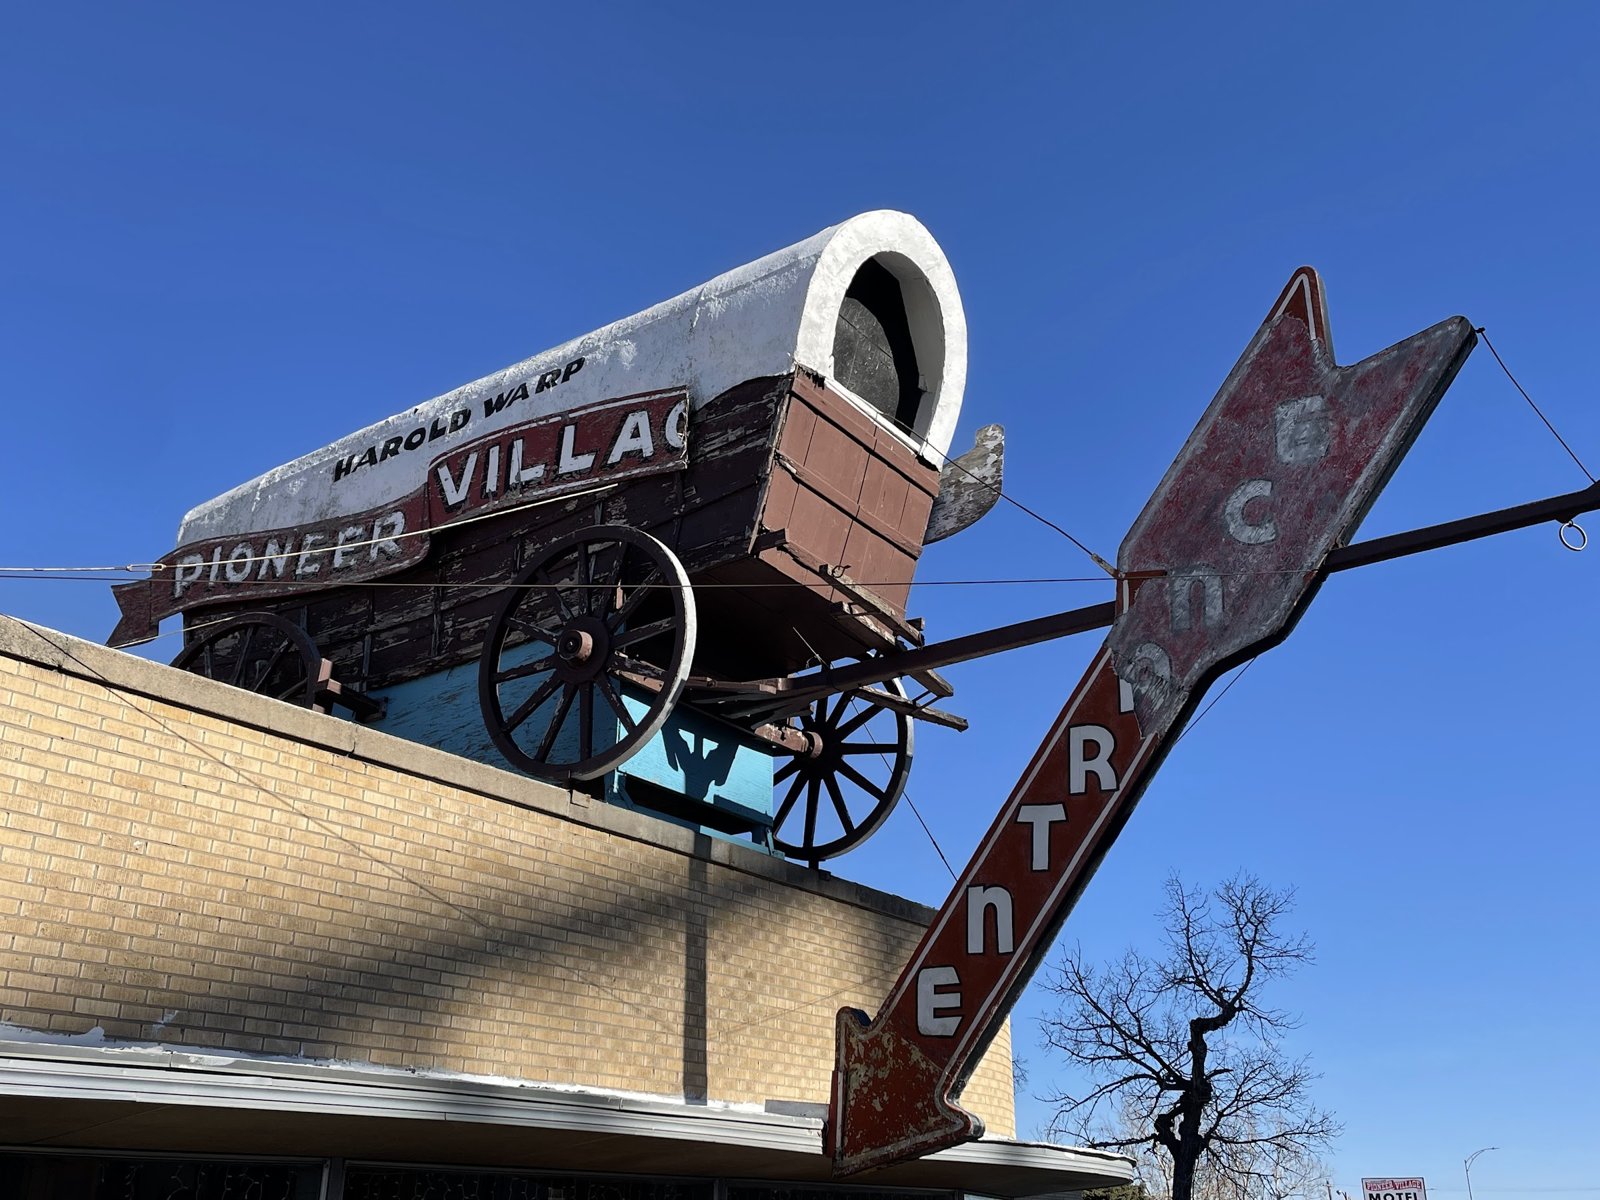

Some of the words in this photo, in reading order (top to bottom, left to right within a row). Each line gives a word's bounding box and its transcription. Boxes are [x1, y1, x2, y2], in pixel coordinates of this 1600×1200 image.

[333, 408, 472, 482] HAROLD
[484, 357, 586, 418] WARP
[173, 511, 407, 599] PIONEER
[1366, 1180, 1393, 1191] PIONEER
[1394, 1180, 1421, 1190] VILLAGE
[1369, 1192, 1418, 1200] MOTEL
